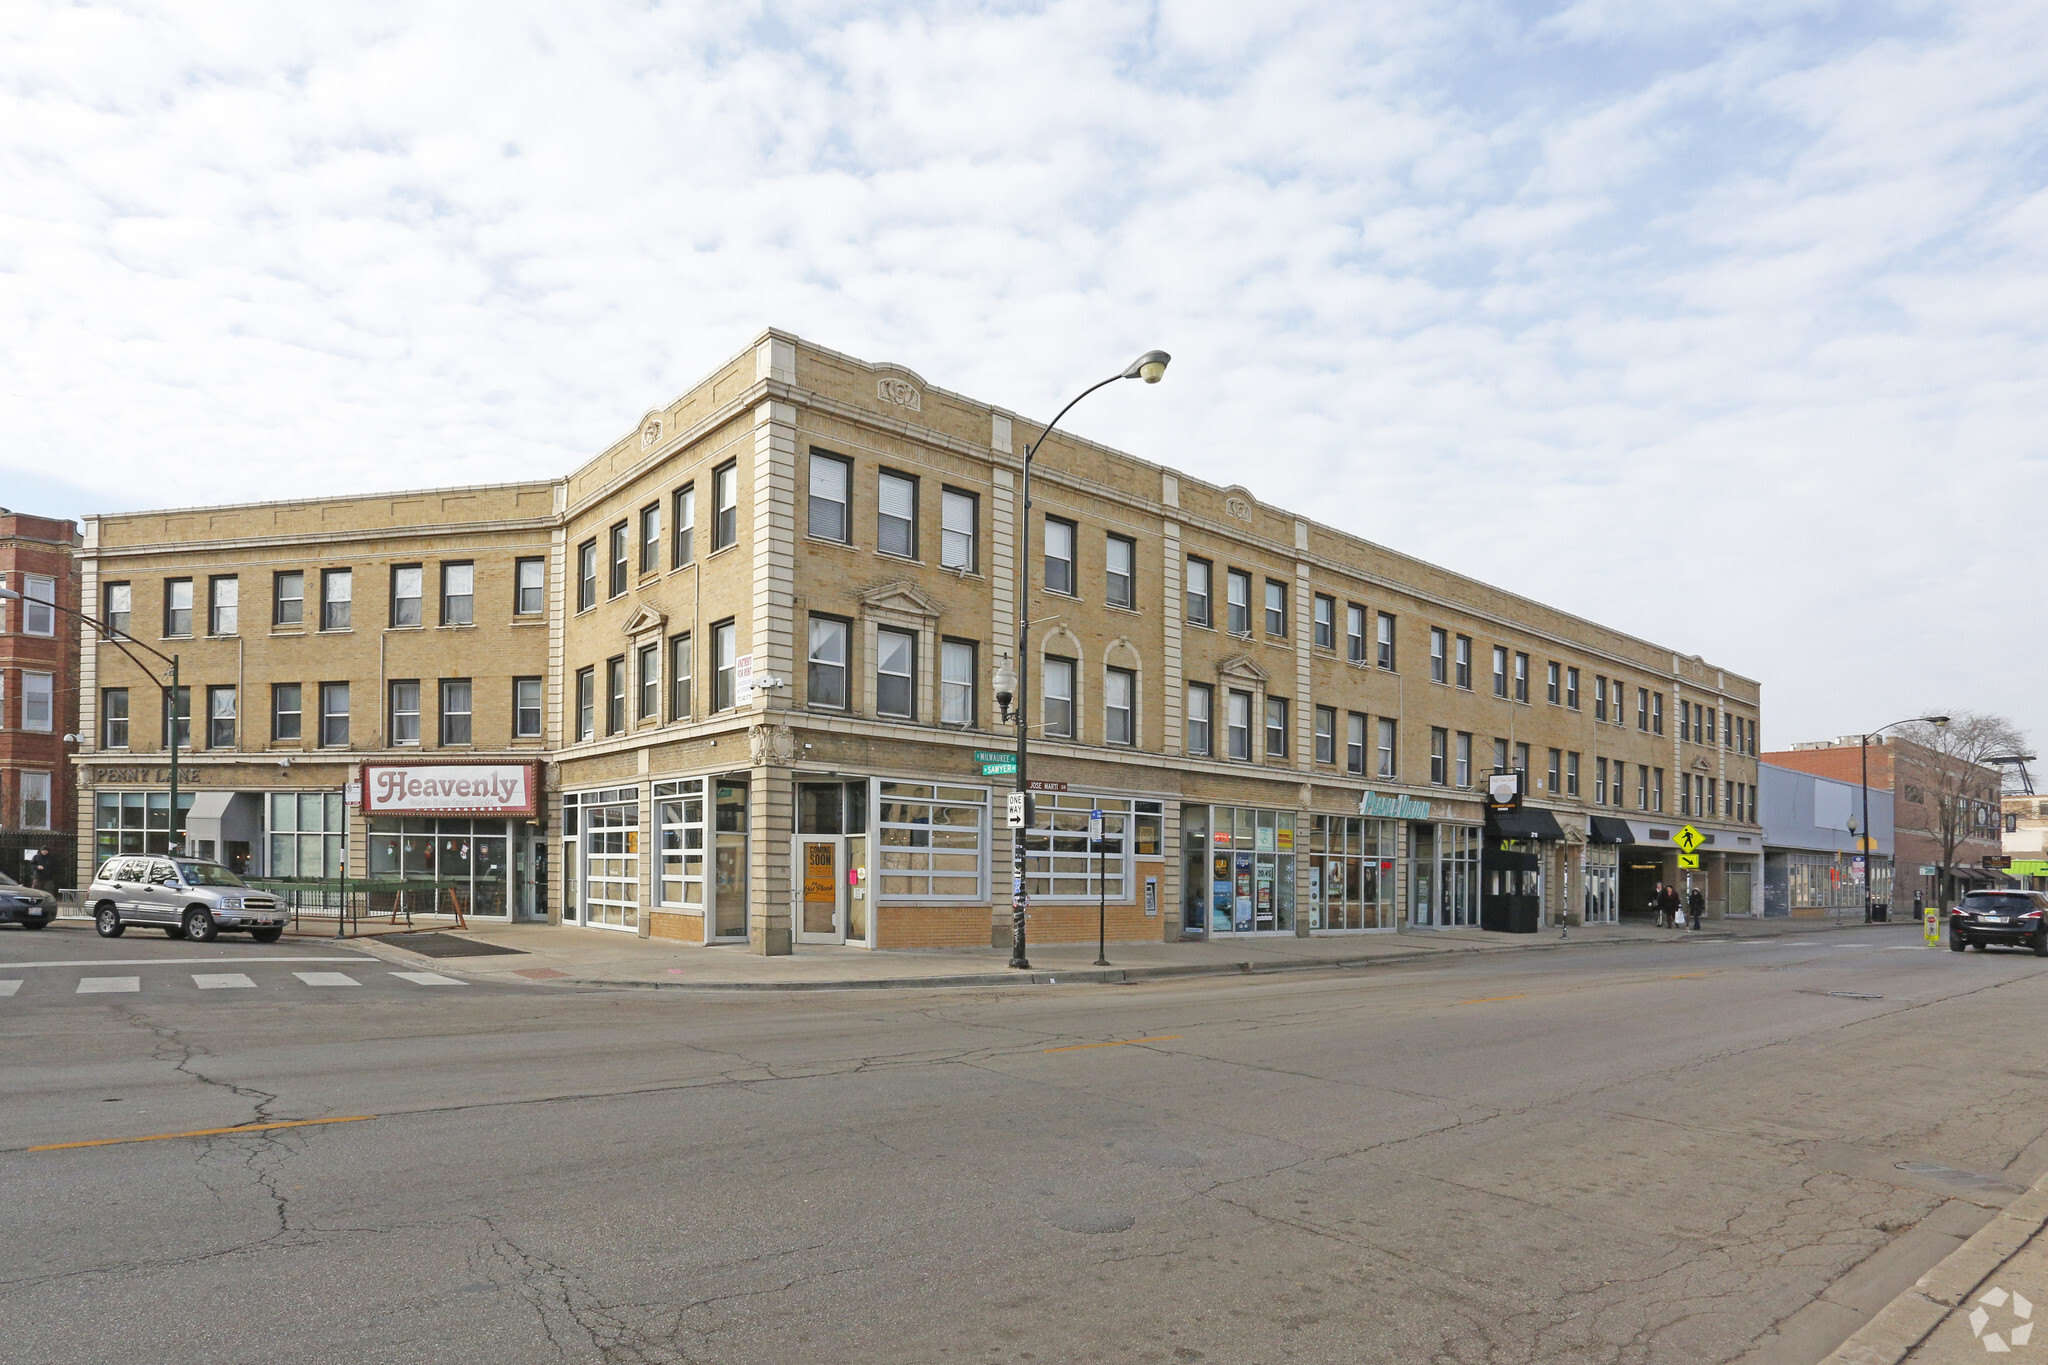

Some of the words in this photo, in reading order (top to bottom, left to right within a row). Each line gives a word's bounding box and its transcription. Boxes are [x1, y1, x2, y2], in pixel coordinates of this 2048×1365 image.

[980, 752, 1010, 763] MILWAUKEE
[988, 765, 1012, 773] SAWYER
[97, 768, 149, 782] PENNY
[377, 771, 518, 803] Heavenly
[1009, 796, 1022, 804] ONE
[1009, 806, 1022, 814] WAY
[810, 854, 831, 865] SOON
